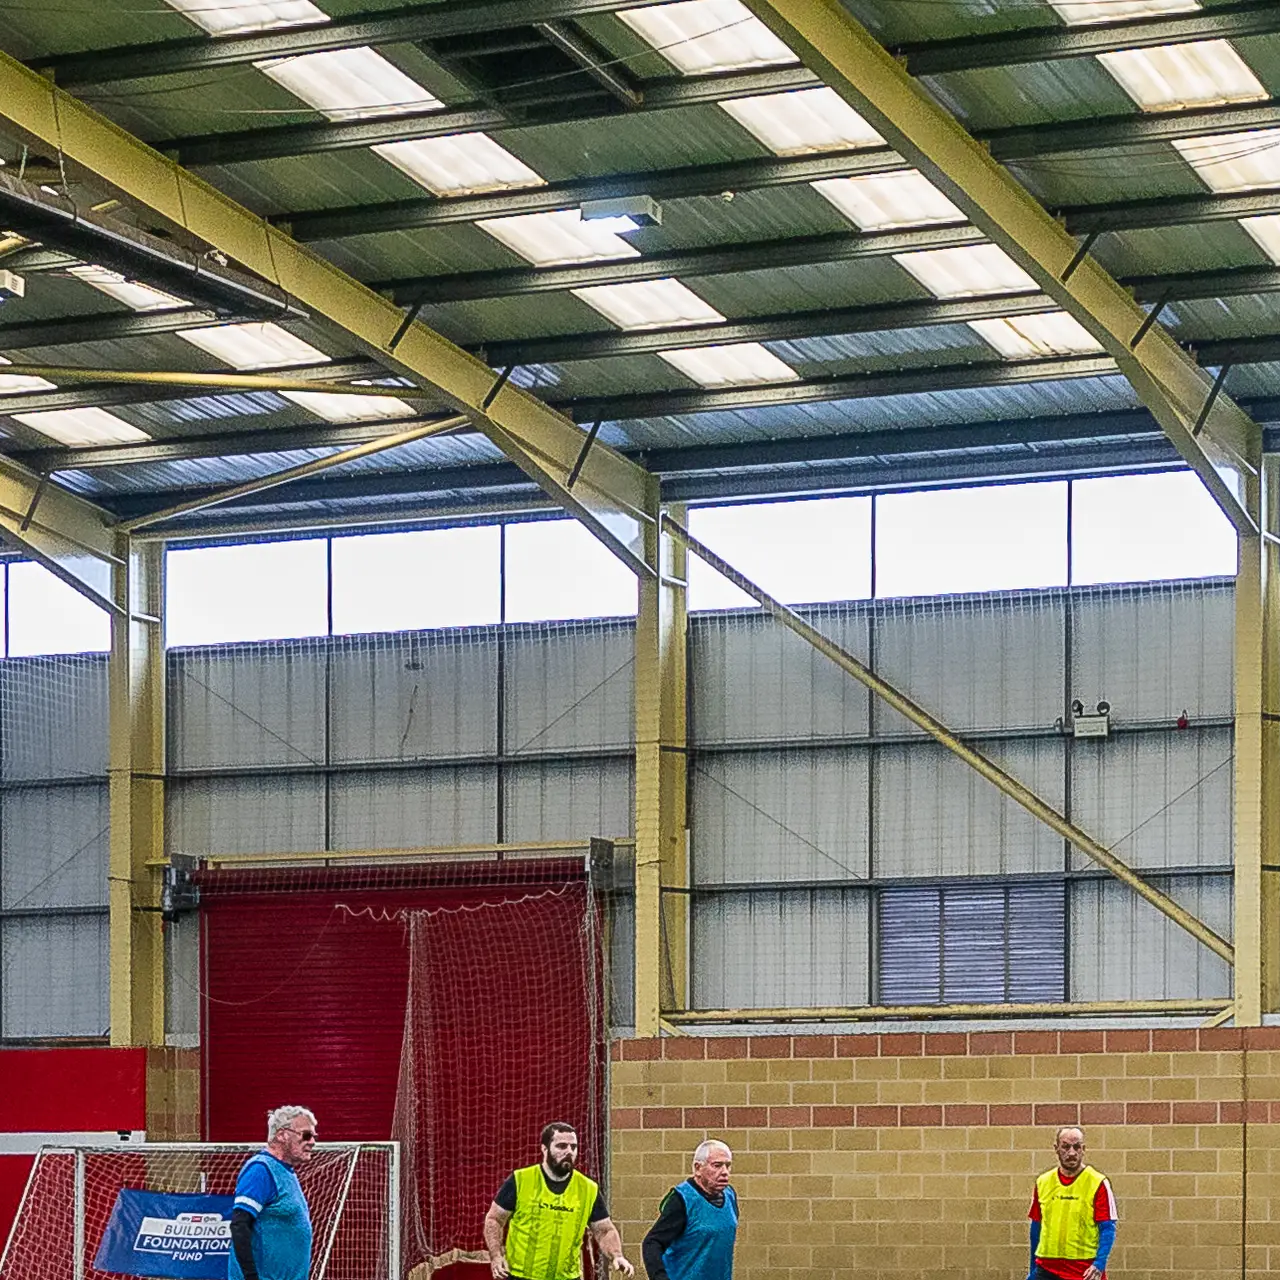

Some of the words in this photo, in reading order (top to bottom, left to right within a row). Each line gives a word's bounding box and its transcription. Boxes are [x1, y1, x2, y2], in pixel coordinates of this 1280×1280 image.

[164, 1225, 227, 1236] BUILDING
[143, 1236, 232, 1250] FOUNDATION
[172, 1252, 202, 1260] FUND
